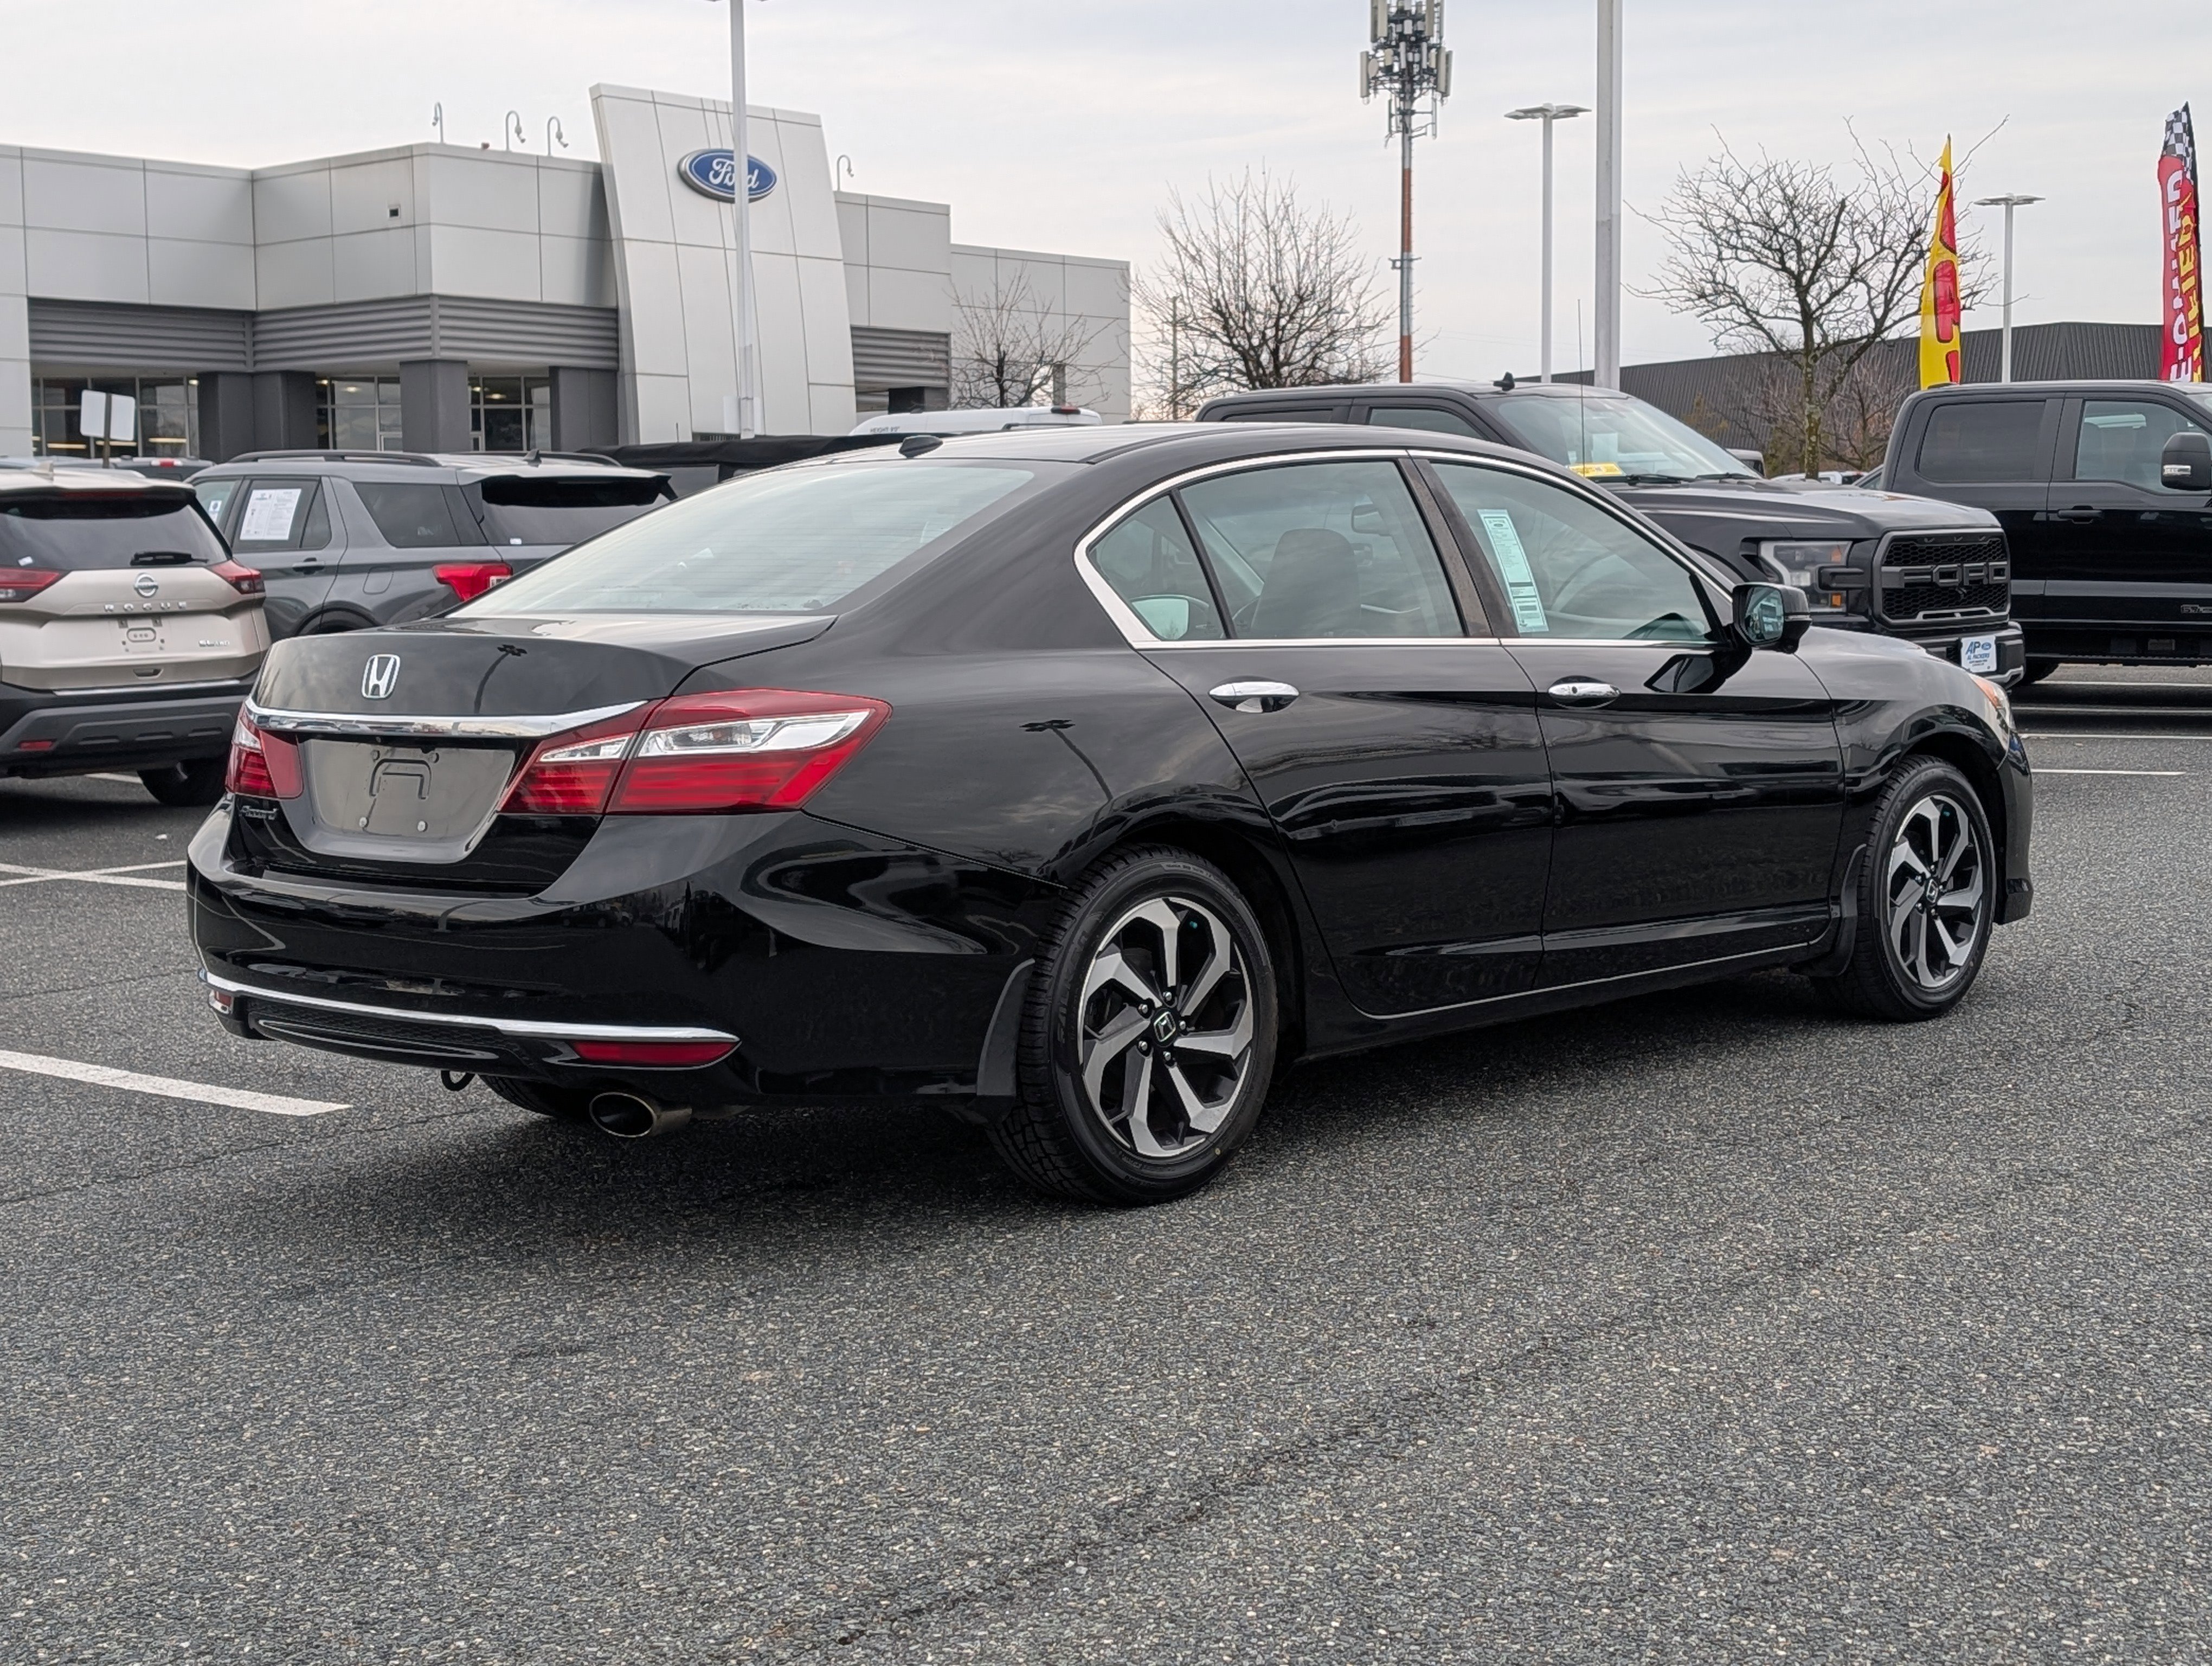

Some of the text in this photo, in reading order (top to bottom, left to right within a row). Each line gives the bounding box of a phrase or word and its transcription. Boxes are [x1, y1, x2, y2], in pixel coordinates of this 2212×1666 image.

[709, 158, 759, 188] Fod
[1891, 561, 2008, 588] FORD
[104, 601, 187, 611] ROGUE
[1965, 641, 1980, 655] AP
